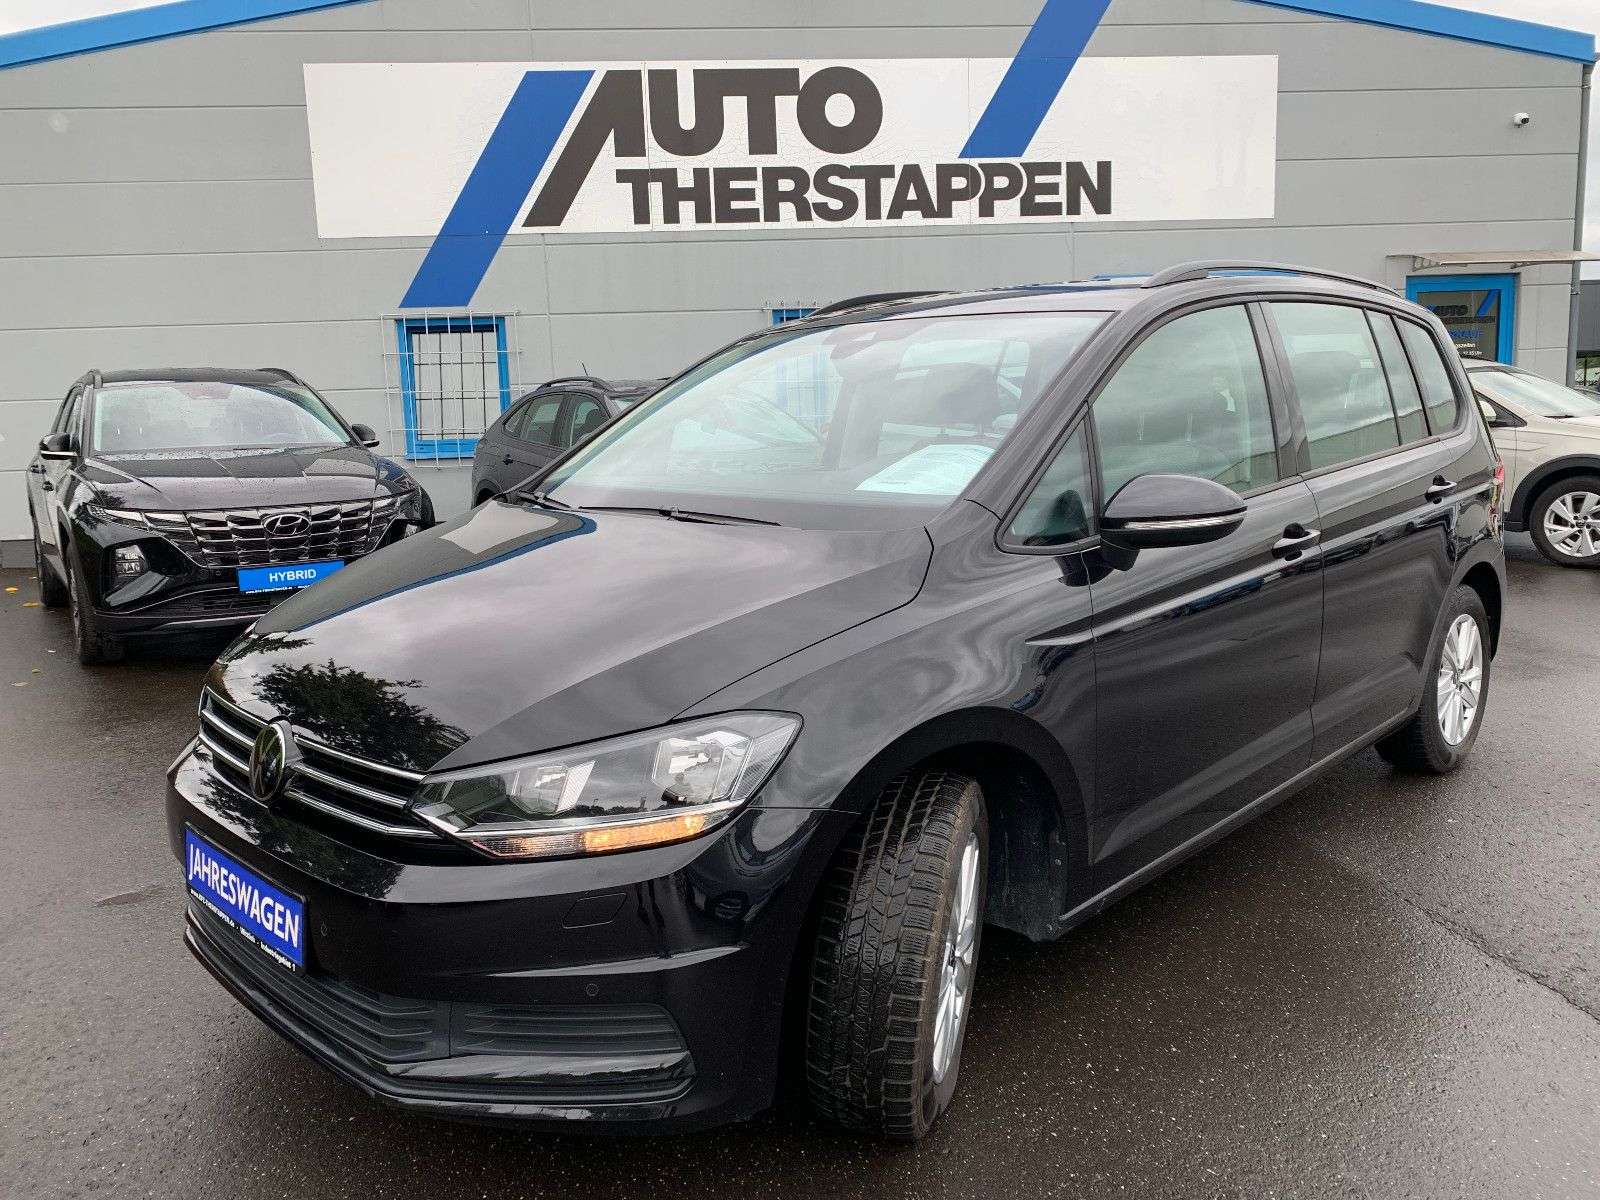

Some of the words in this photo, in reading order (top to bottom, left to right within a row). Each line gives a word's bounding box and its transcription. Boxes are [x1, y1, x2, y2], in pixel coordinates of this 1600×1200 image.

[522, 65, 883, 227] AUTO
[616, 161, 1112, 225] THERSTAPPEN
[269, 569, 316, 583] HYBRID
[188, 843, 299, 948] JAHRESWAGEN
